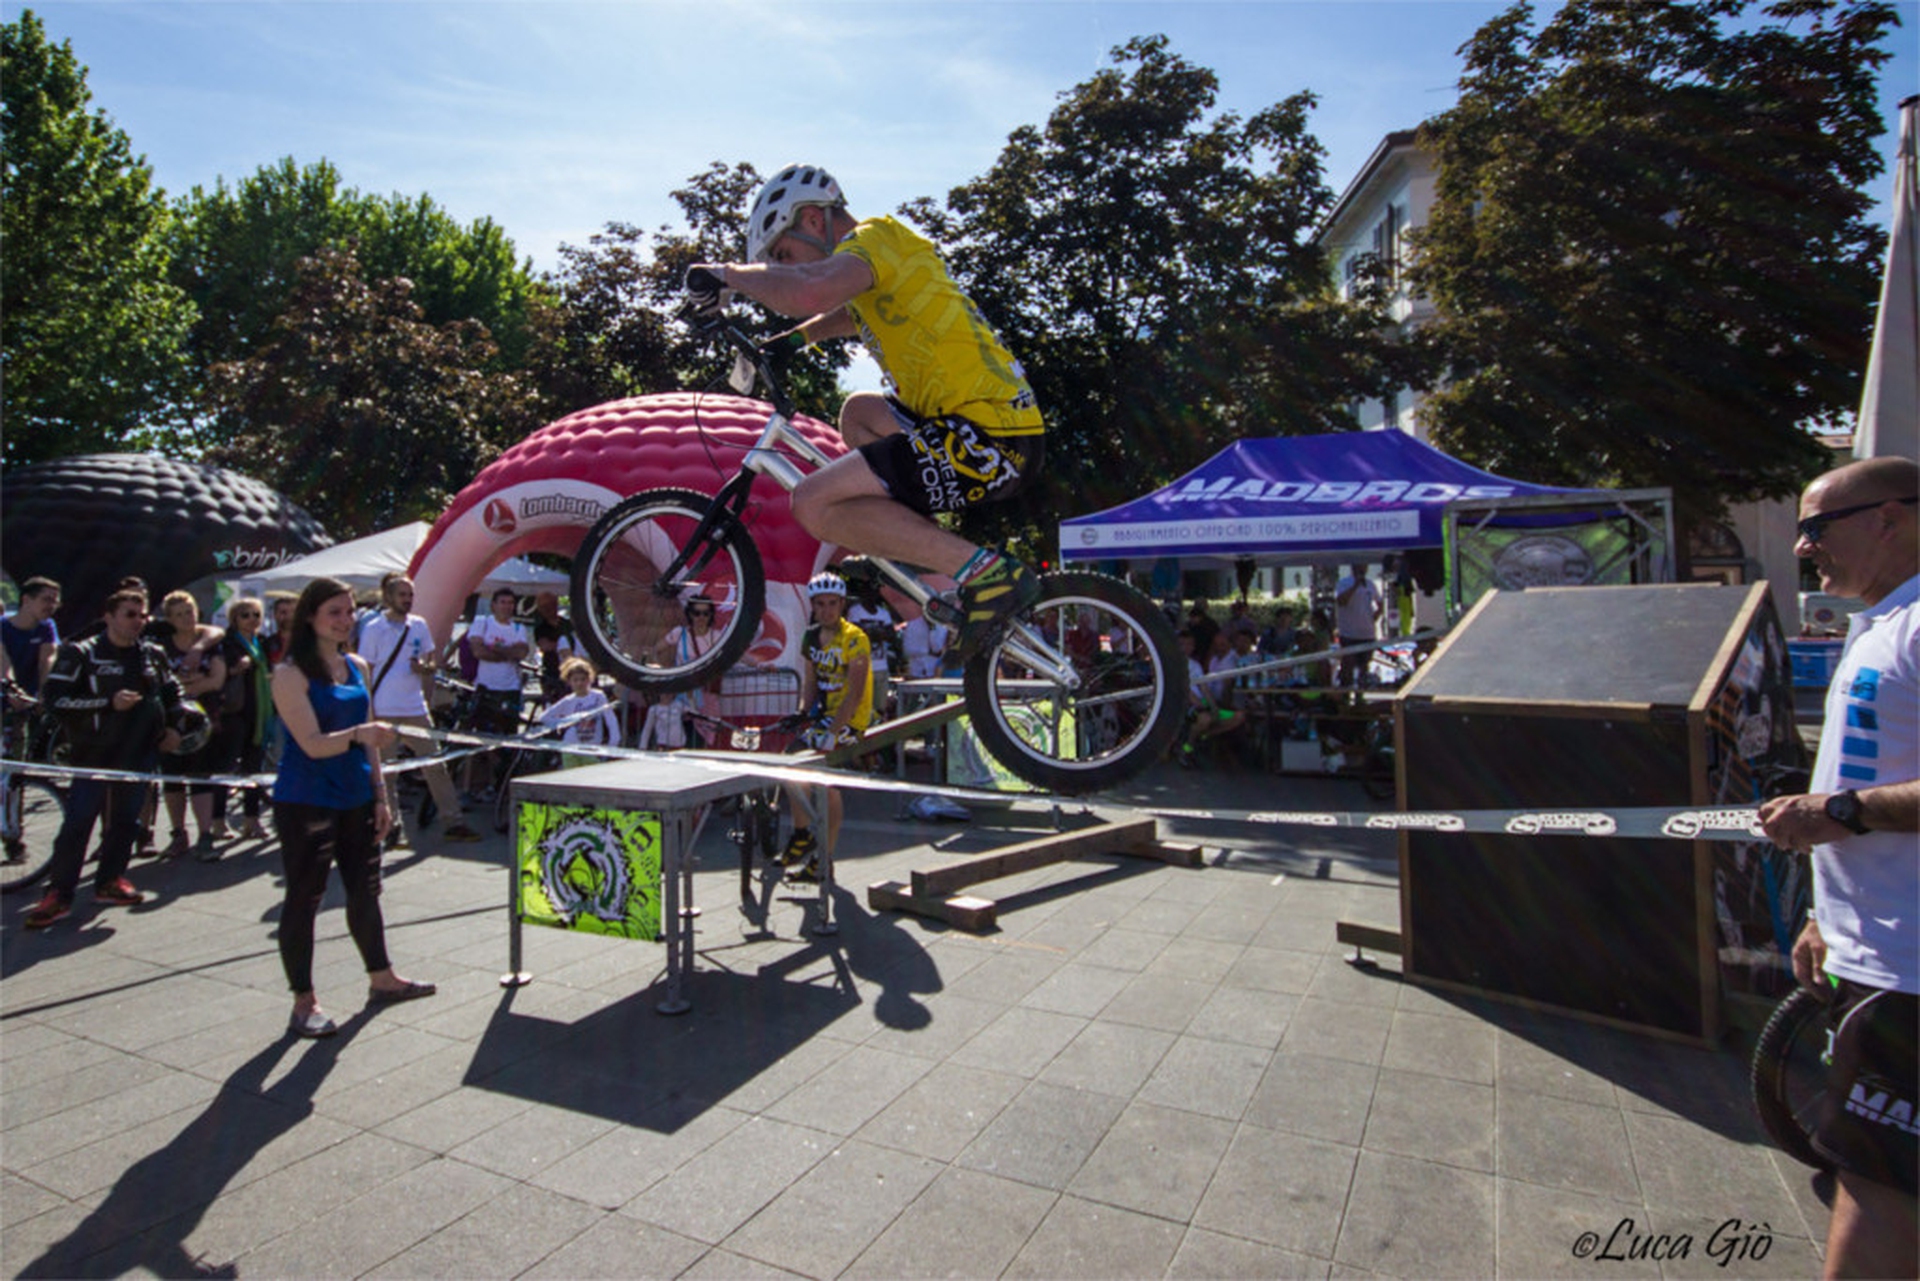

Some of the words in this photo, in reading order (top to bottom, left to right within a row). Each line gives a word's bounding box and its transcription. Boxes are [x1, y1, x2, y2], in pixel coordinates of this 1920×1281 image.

[1169, 476, 1515, 503] MADBROS
[1258, 521, 1296, 535] 100%
[1845, 1083, 1918, 1136] MA
